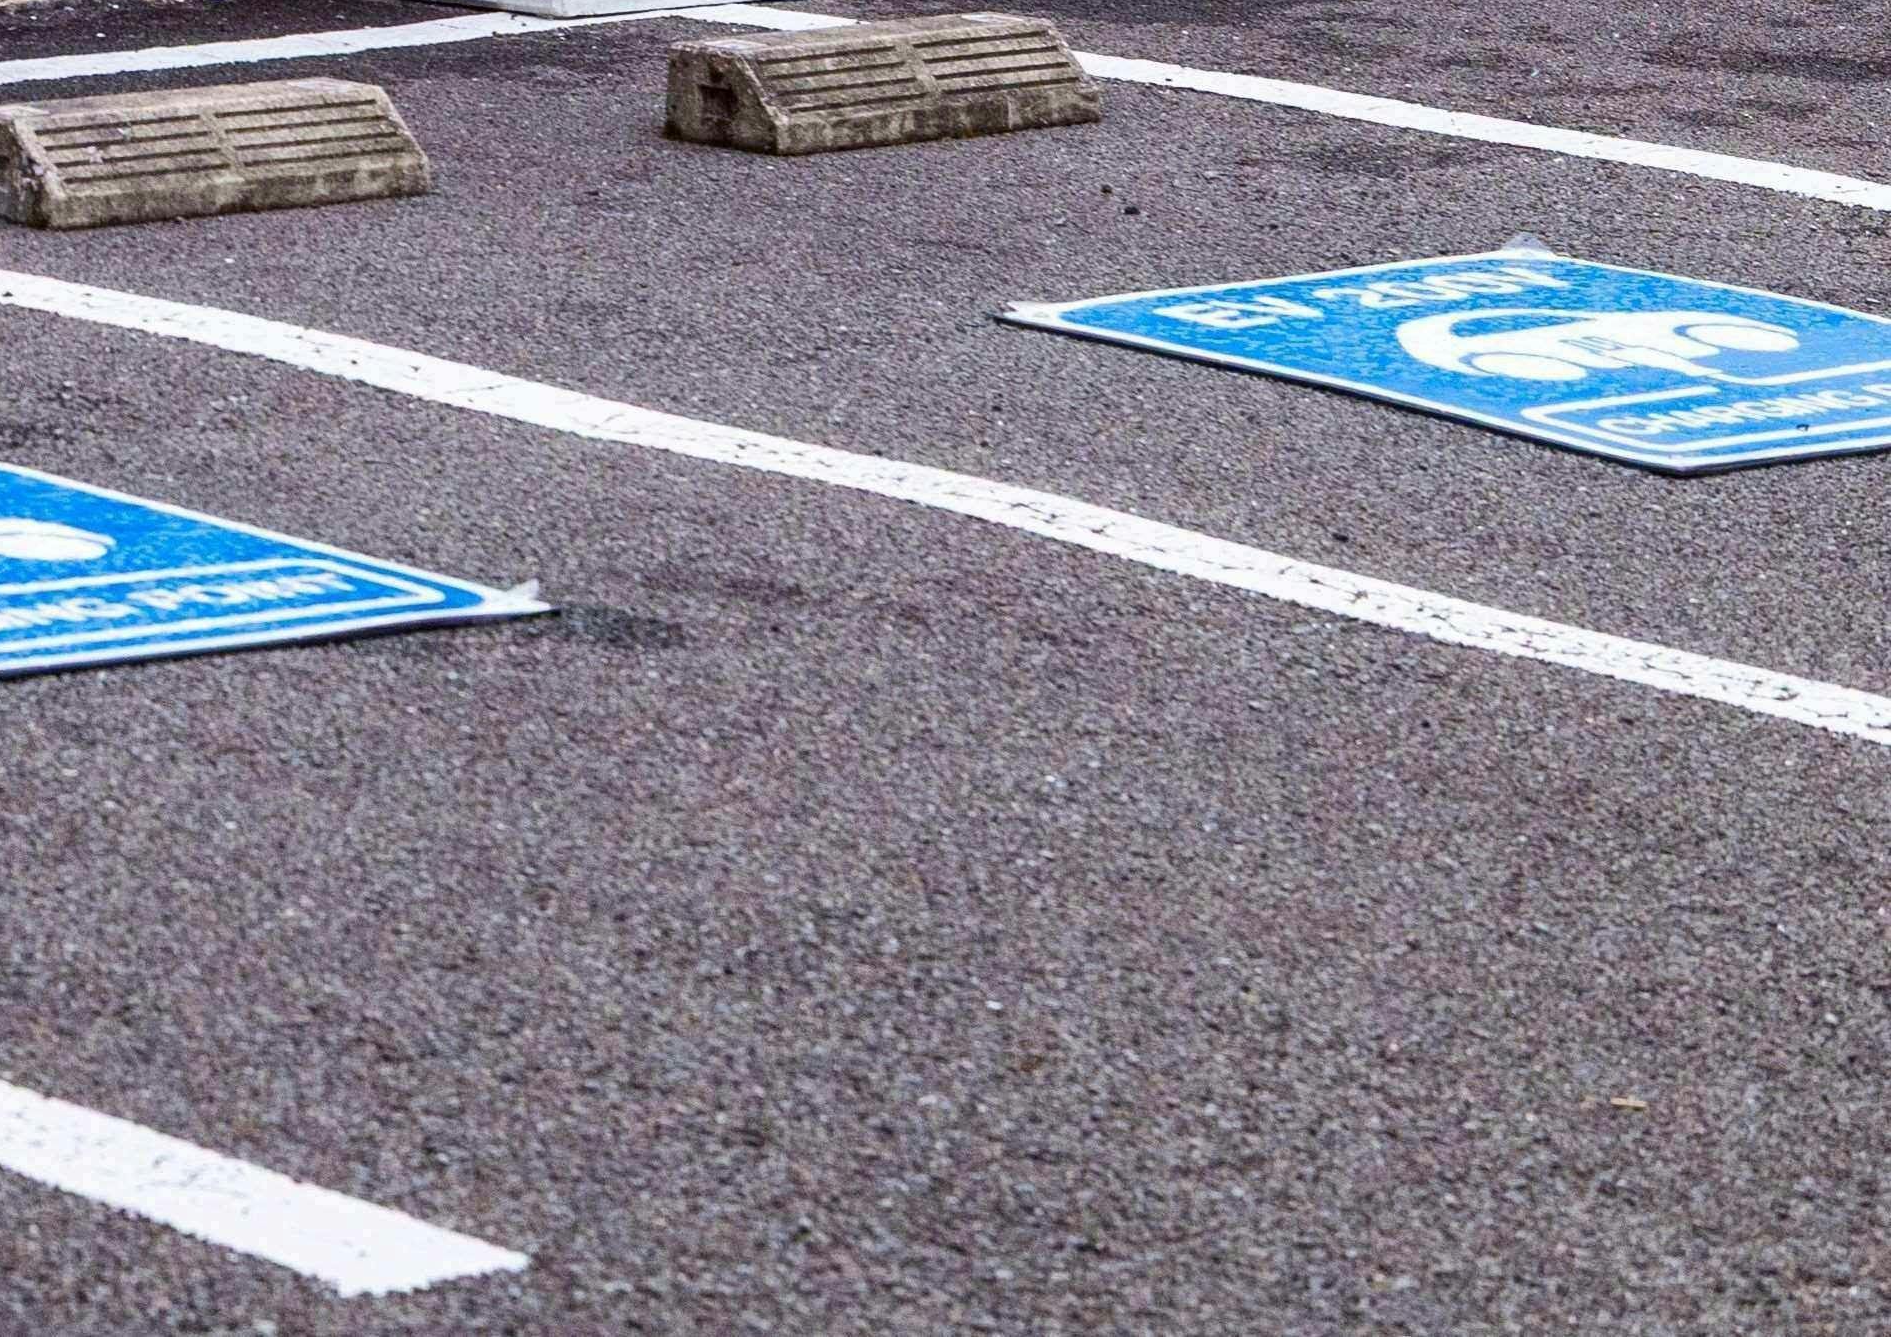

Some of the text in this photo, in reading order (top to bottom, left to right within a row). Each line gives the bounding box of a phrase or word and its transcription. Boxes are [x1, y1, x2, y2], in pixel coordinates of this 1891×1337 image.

[1153, 267, 1568, 329] EV 200V
[122, 571, 356, 611] POINT
